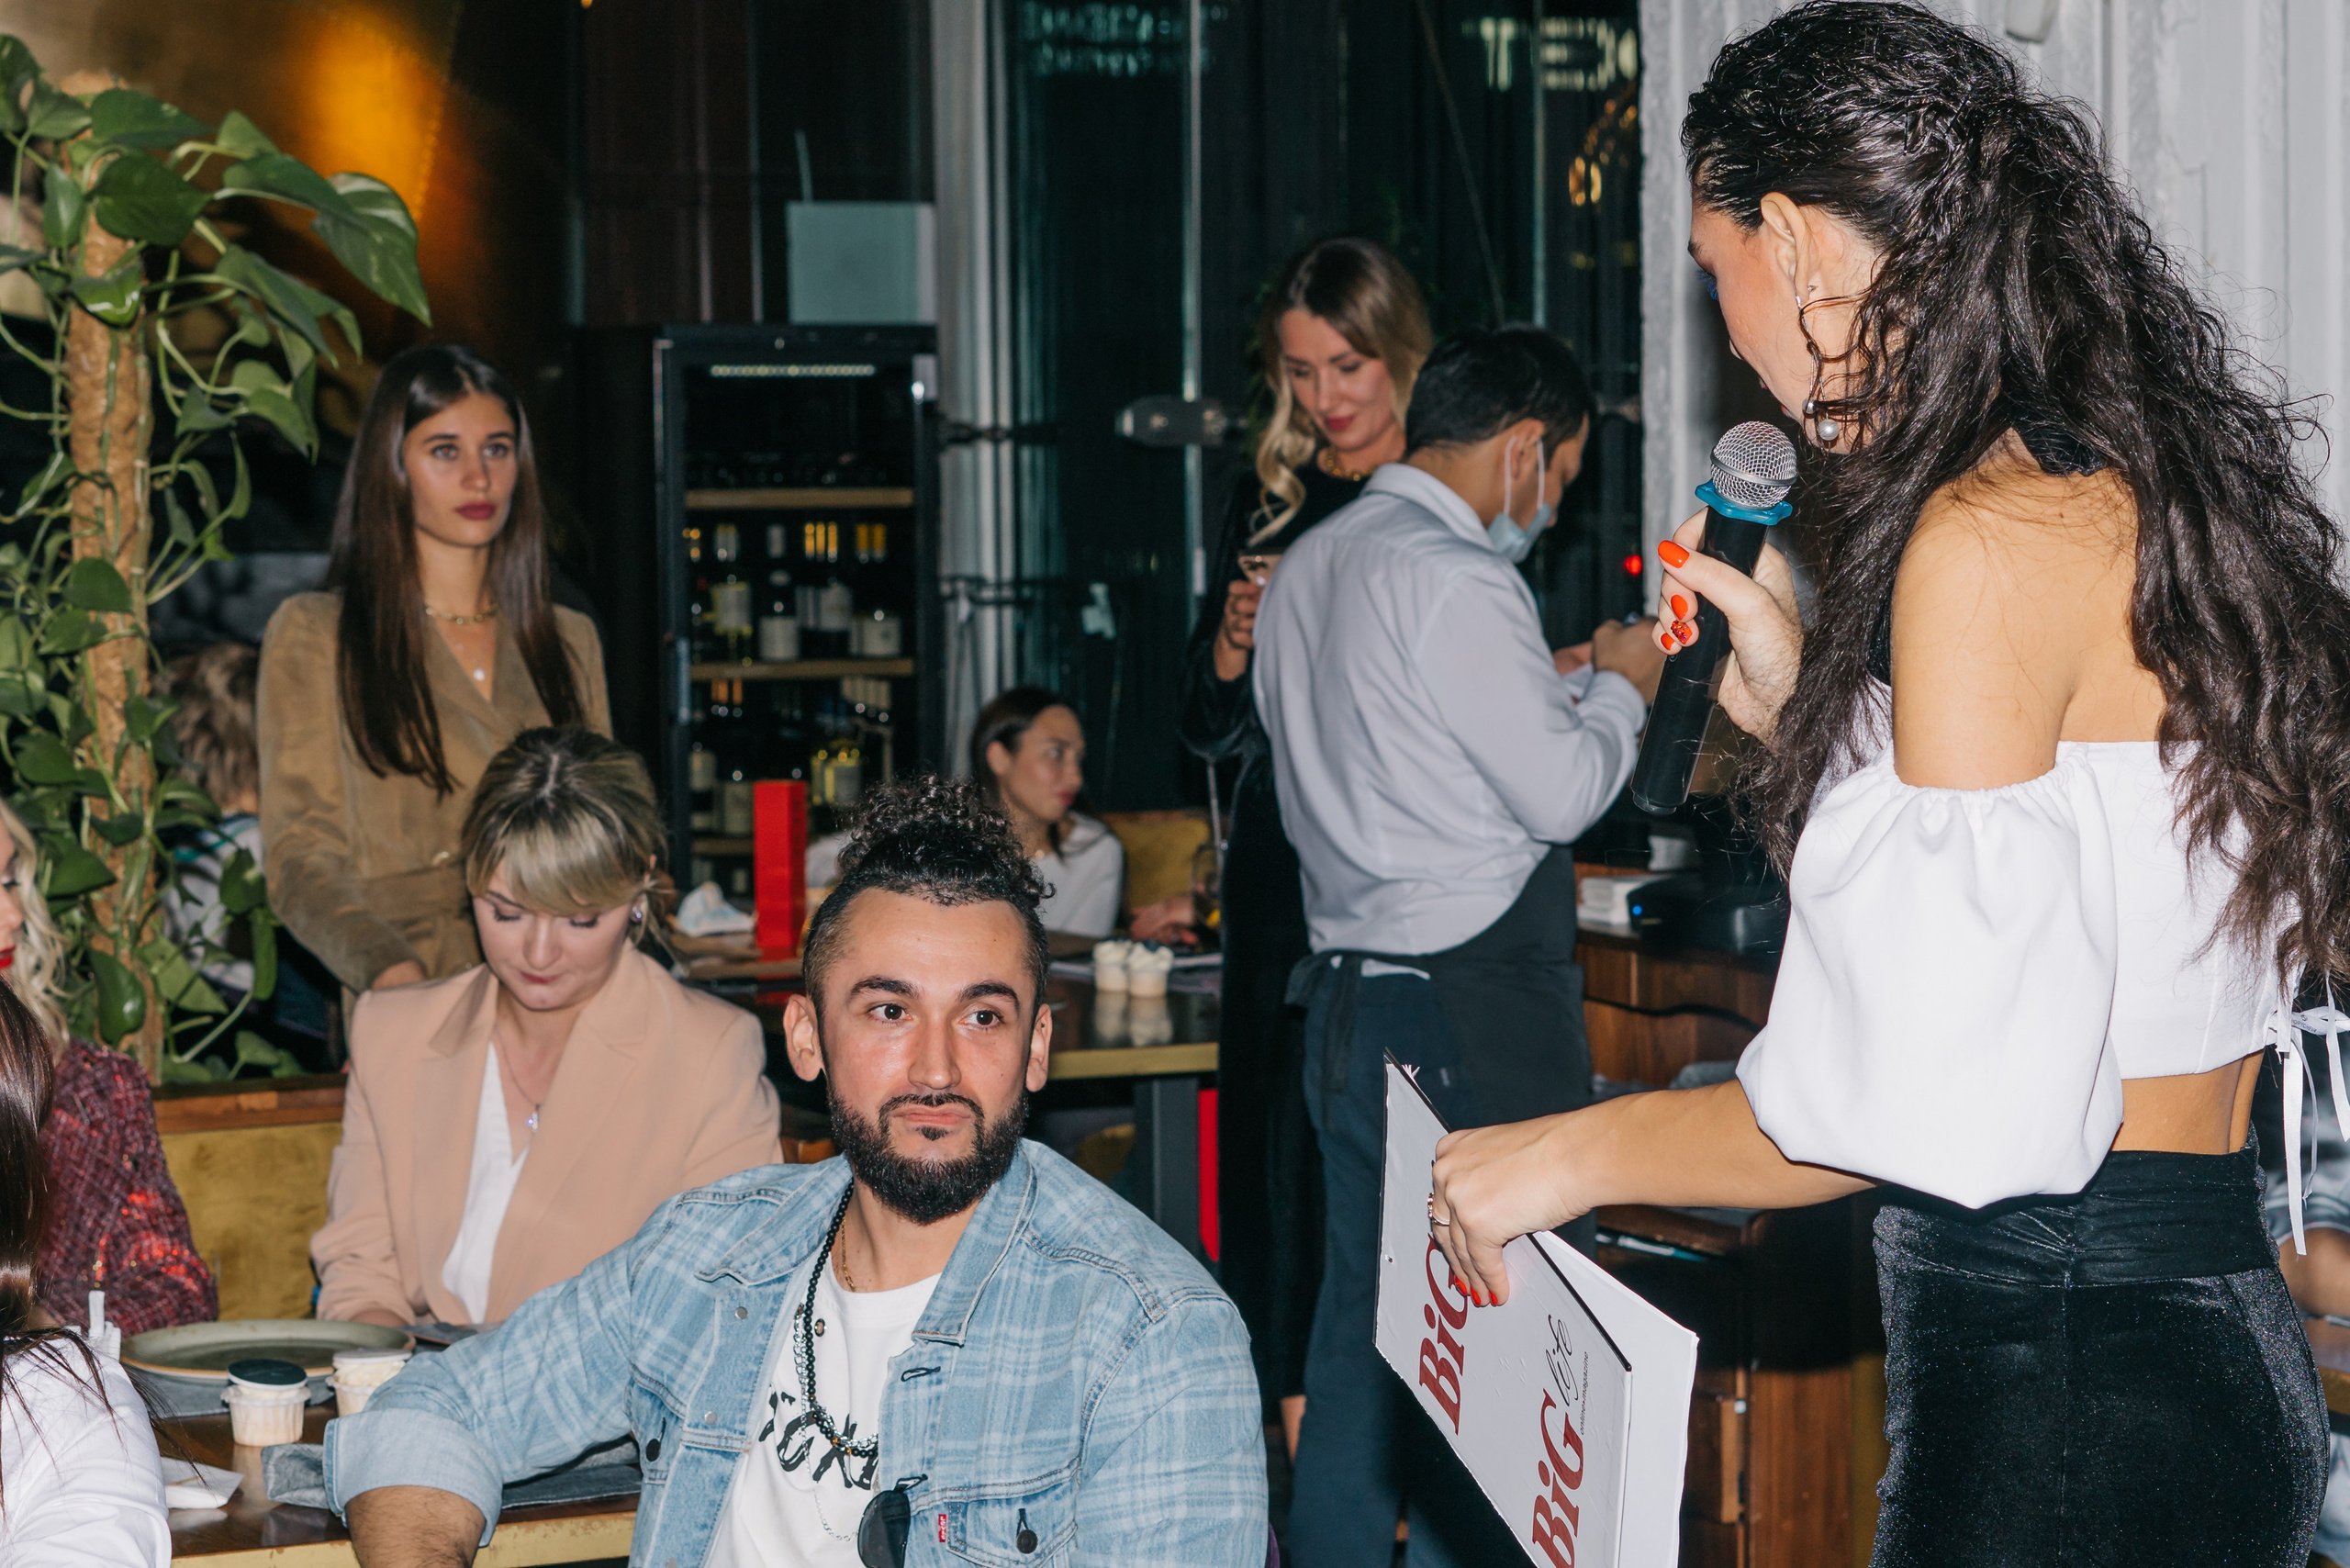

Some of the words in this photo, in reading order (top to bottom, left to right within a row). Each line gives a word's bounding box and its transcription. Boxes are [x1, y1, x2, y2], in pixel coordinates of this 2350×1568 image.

[1419, 1232, 1469, 1436] BiG
[1546, 1314, 1579, 1407] life
[1532, 1387, 1584, 1568] BiG
